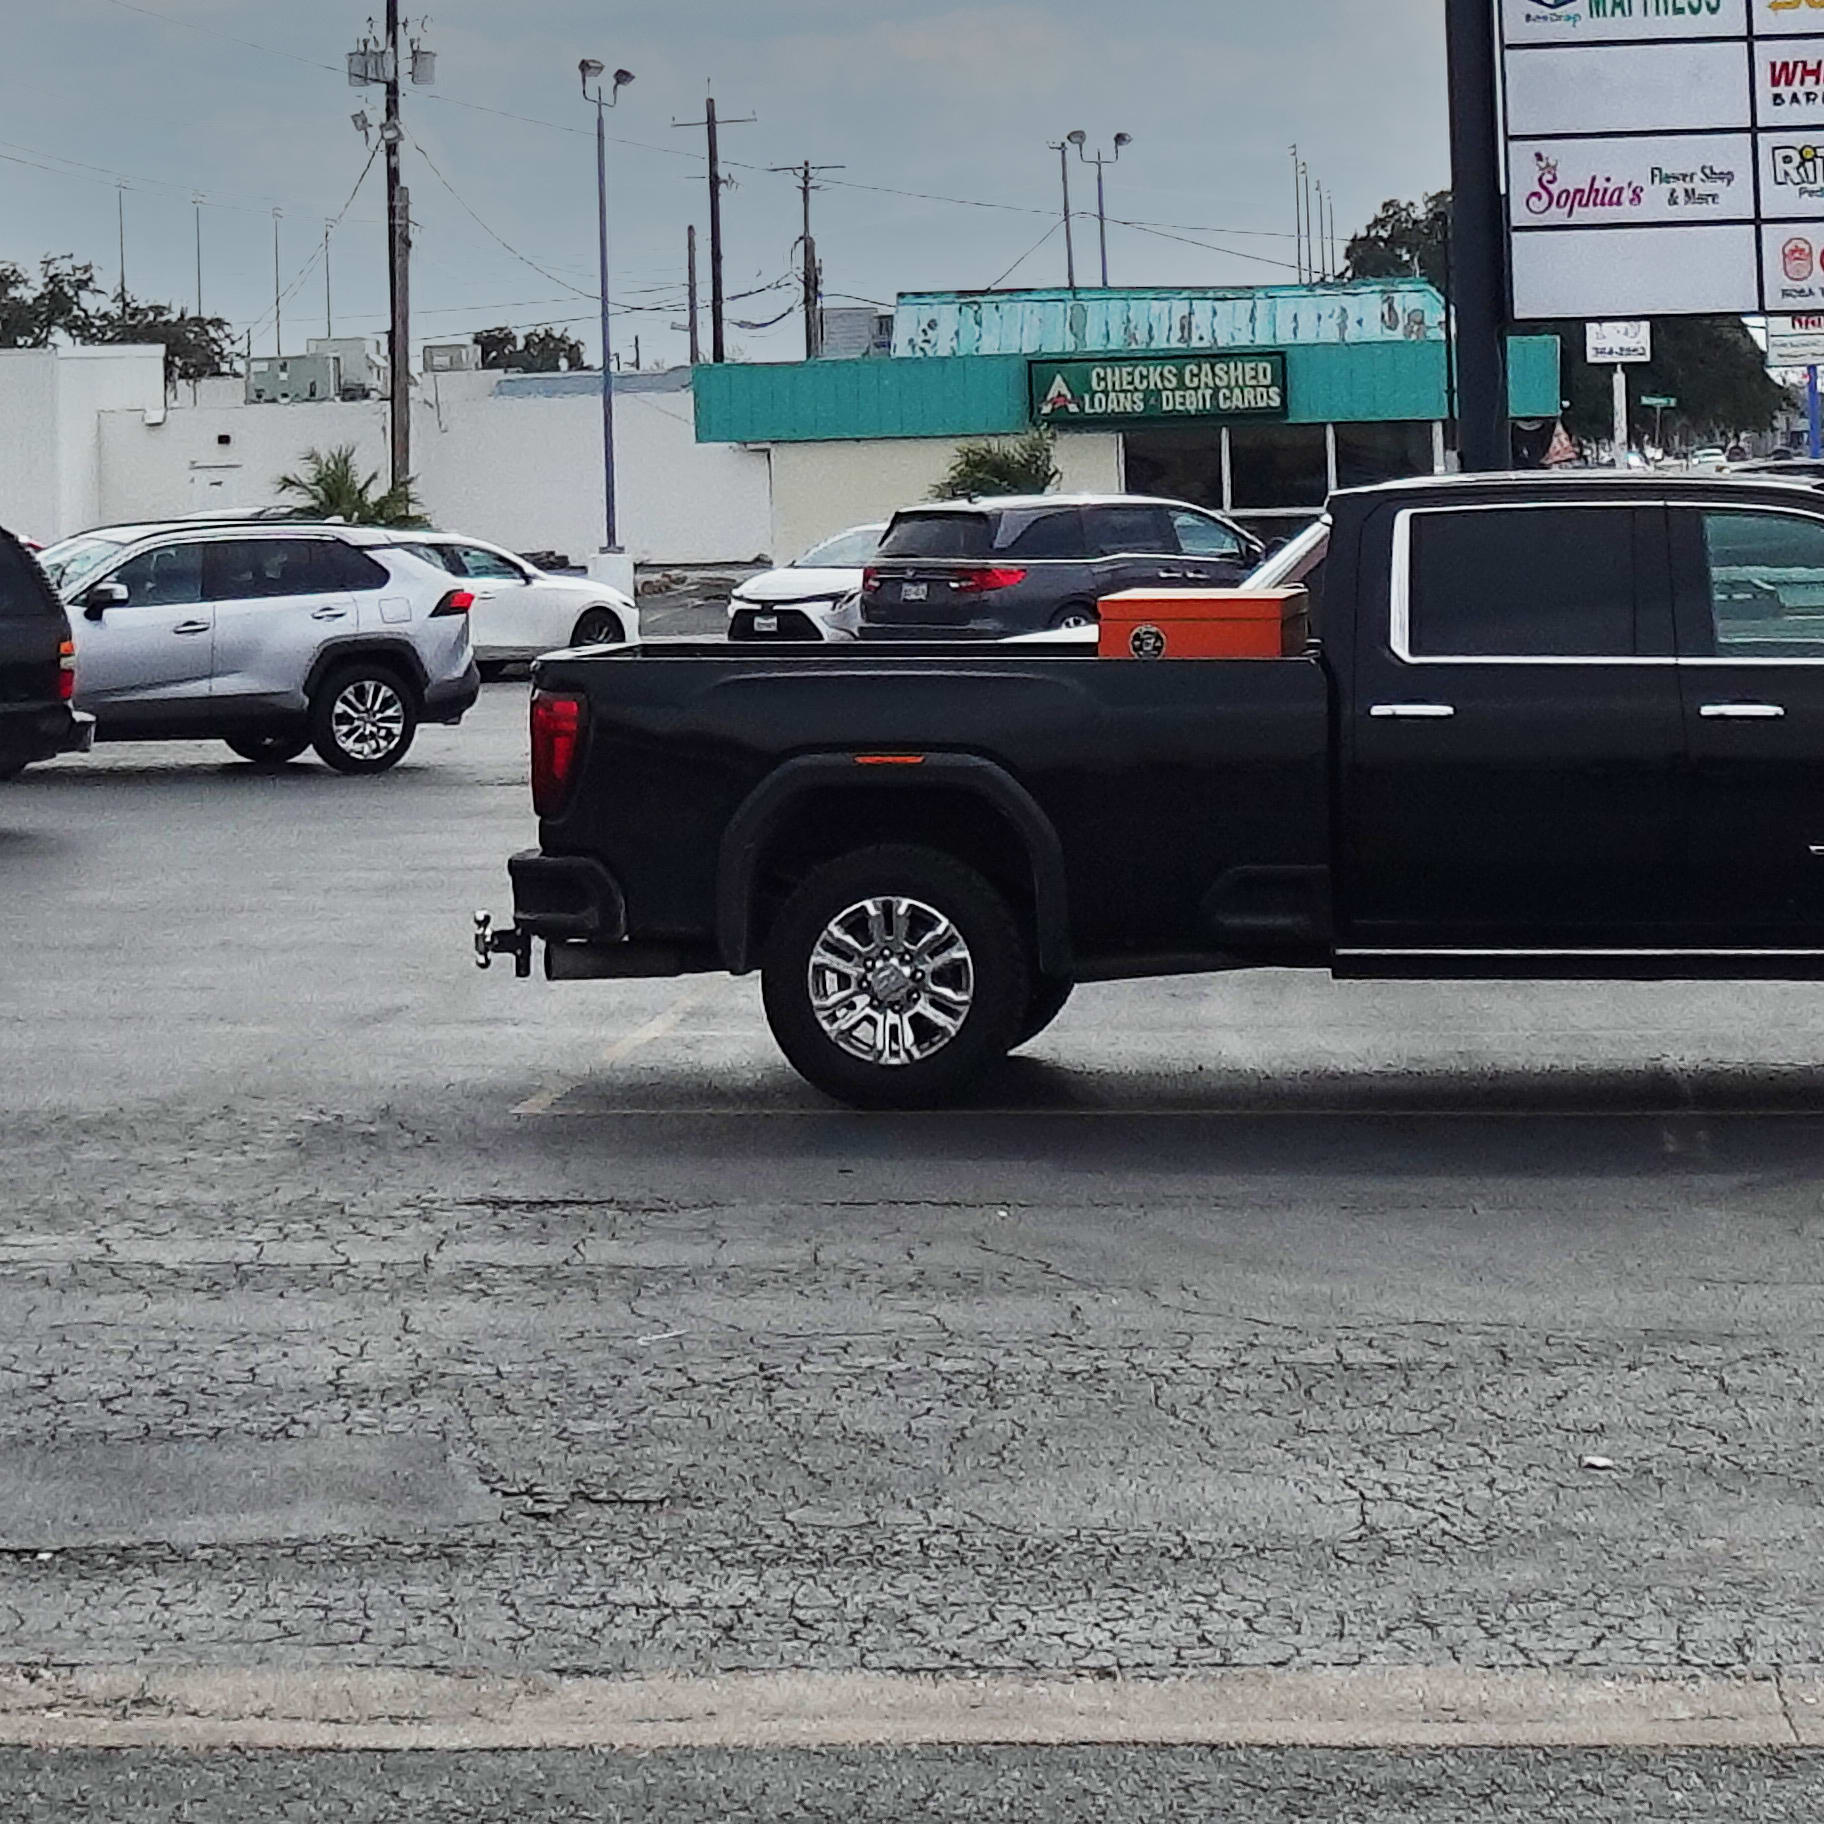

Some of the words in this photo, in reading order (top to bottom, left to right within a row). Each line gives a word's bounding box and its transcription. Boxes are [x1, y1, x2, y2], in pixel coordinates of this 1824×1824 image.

[1526, 172, 1644, 218] Sophia's
[1091, 363, 1177, 392] CHECKS
[1184, 361, 1273, 389] CASHED
[1084, 391, 1145, 415] LOANS
[1161, 388, 1214, 413] DEBIT
[1218, 385, 1282, 410] CARDS
